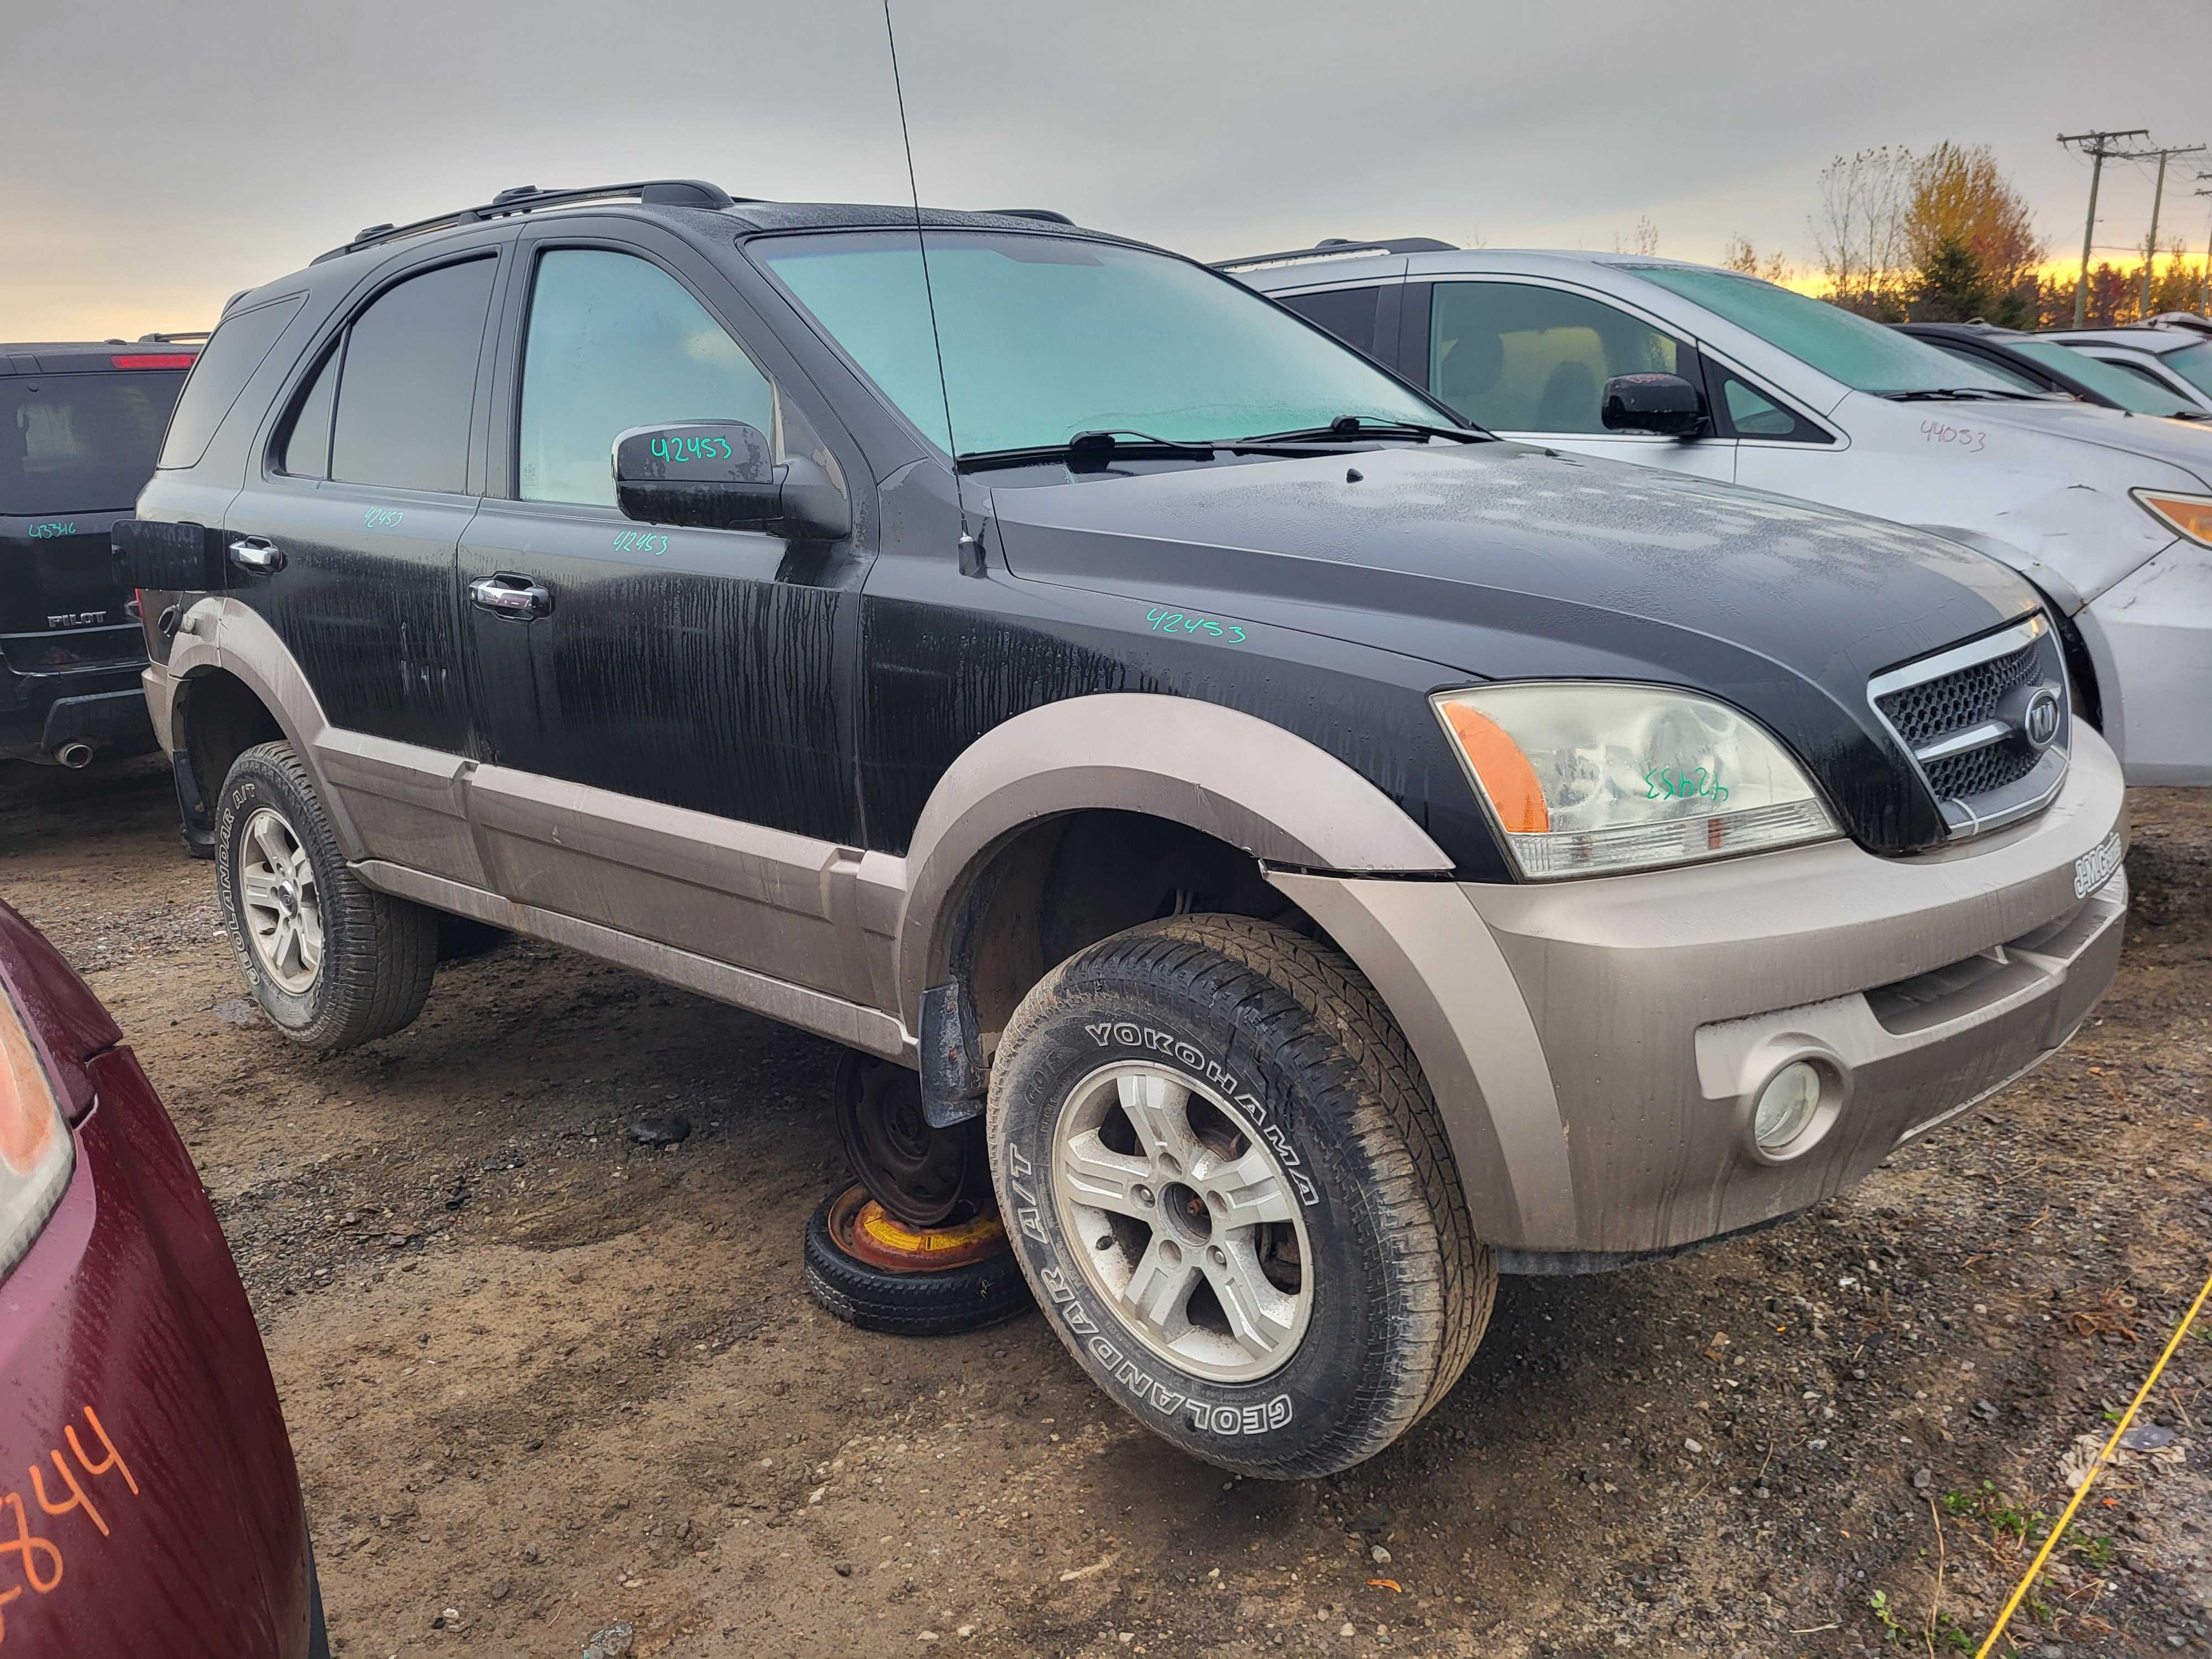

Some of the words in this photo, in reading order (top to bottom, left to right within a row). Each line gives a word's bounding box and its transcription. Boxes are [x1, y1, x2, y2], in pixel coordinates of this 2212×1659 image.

[651, 437, 732, 462] 42453
[1921, 420, 1986, 452] 44053
[613, 531, 668, 555] 42453
[48, 611, 106, 628] PILOT
[1146, 607, 1246, 643] 42453
[232, 783, 255, 810] A/T
[218, 807, 260, 985] GEOLANDAR
[1085, 1022, 1321, 1206] YOKOHAMA
[1009, 1142, 1049, 1244] A/T
[1041, 1266, 1293, 1435] GEOLANDAR
[0, 1405, 139, 1644] 844
